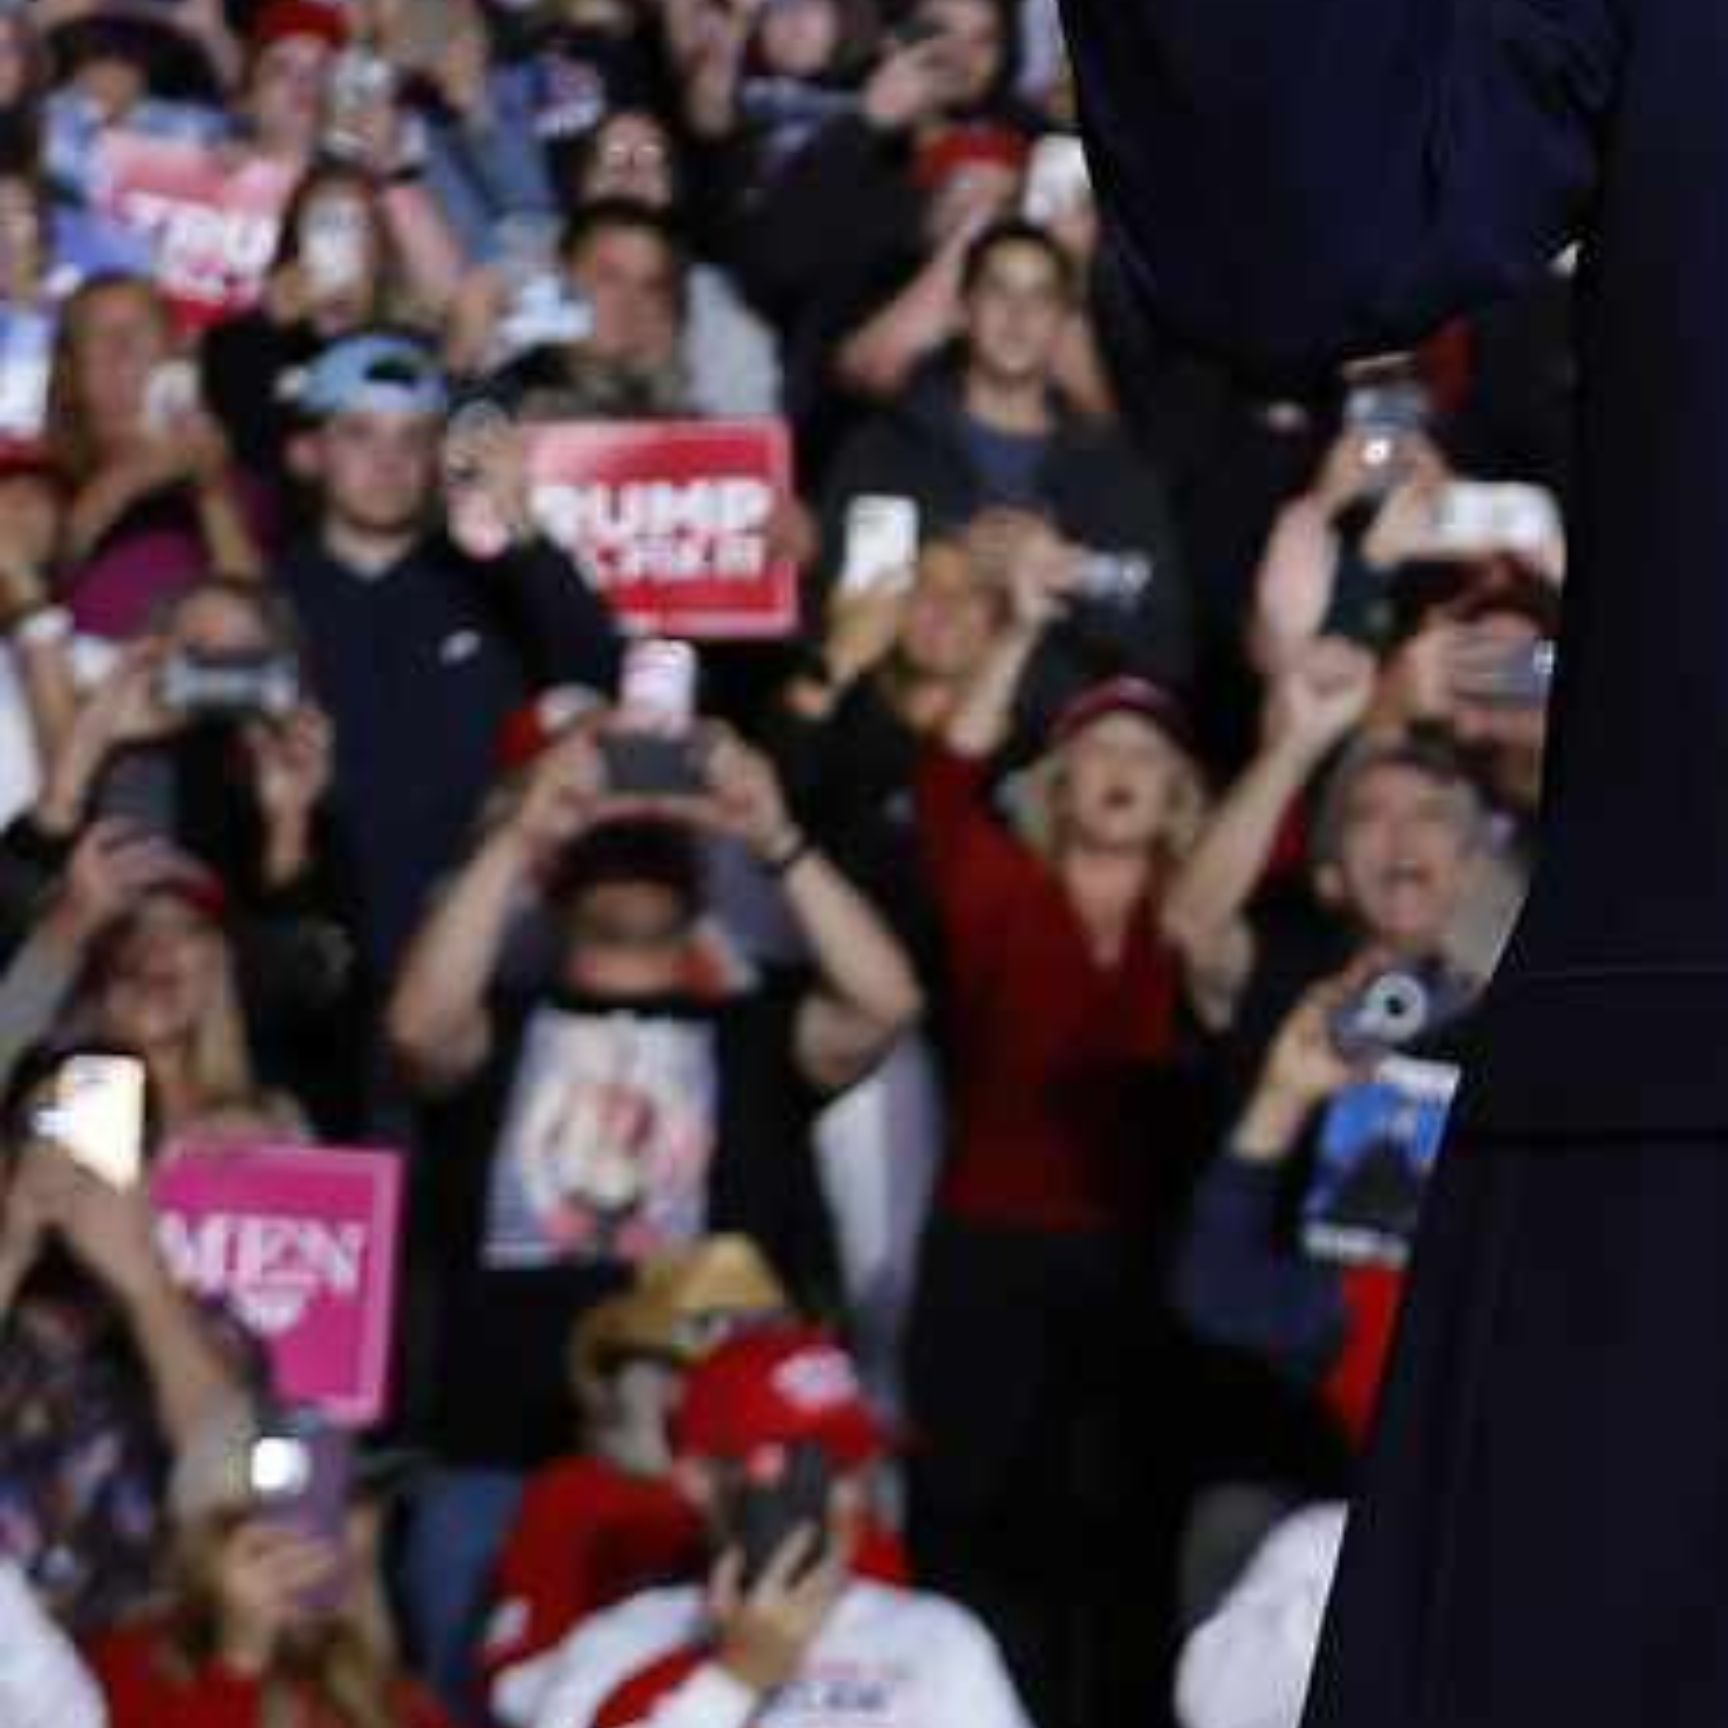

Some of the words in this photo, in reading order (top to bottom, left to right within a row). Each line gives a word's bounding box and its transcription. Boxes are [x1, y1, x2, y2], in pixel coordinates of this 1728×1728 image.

[124, 188, 278, 276] TRU
[530, 474, 772, 546] RUMP
[158, 1208, 368, 1296] MEN
